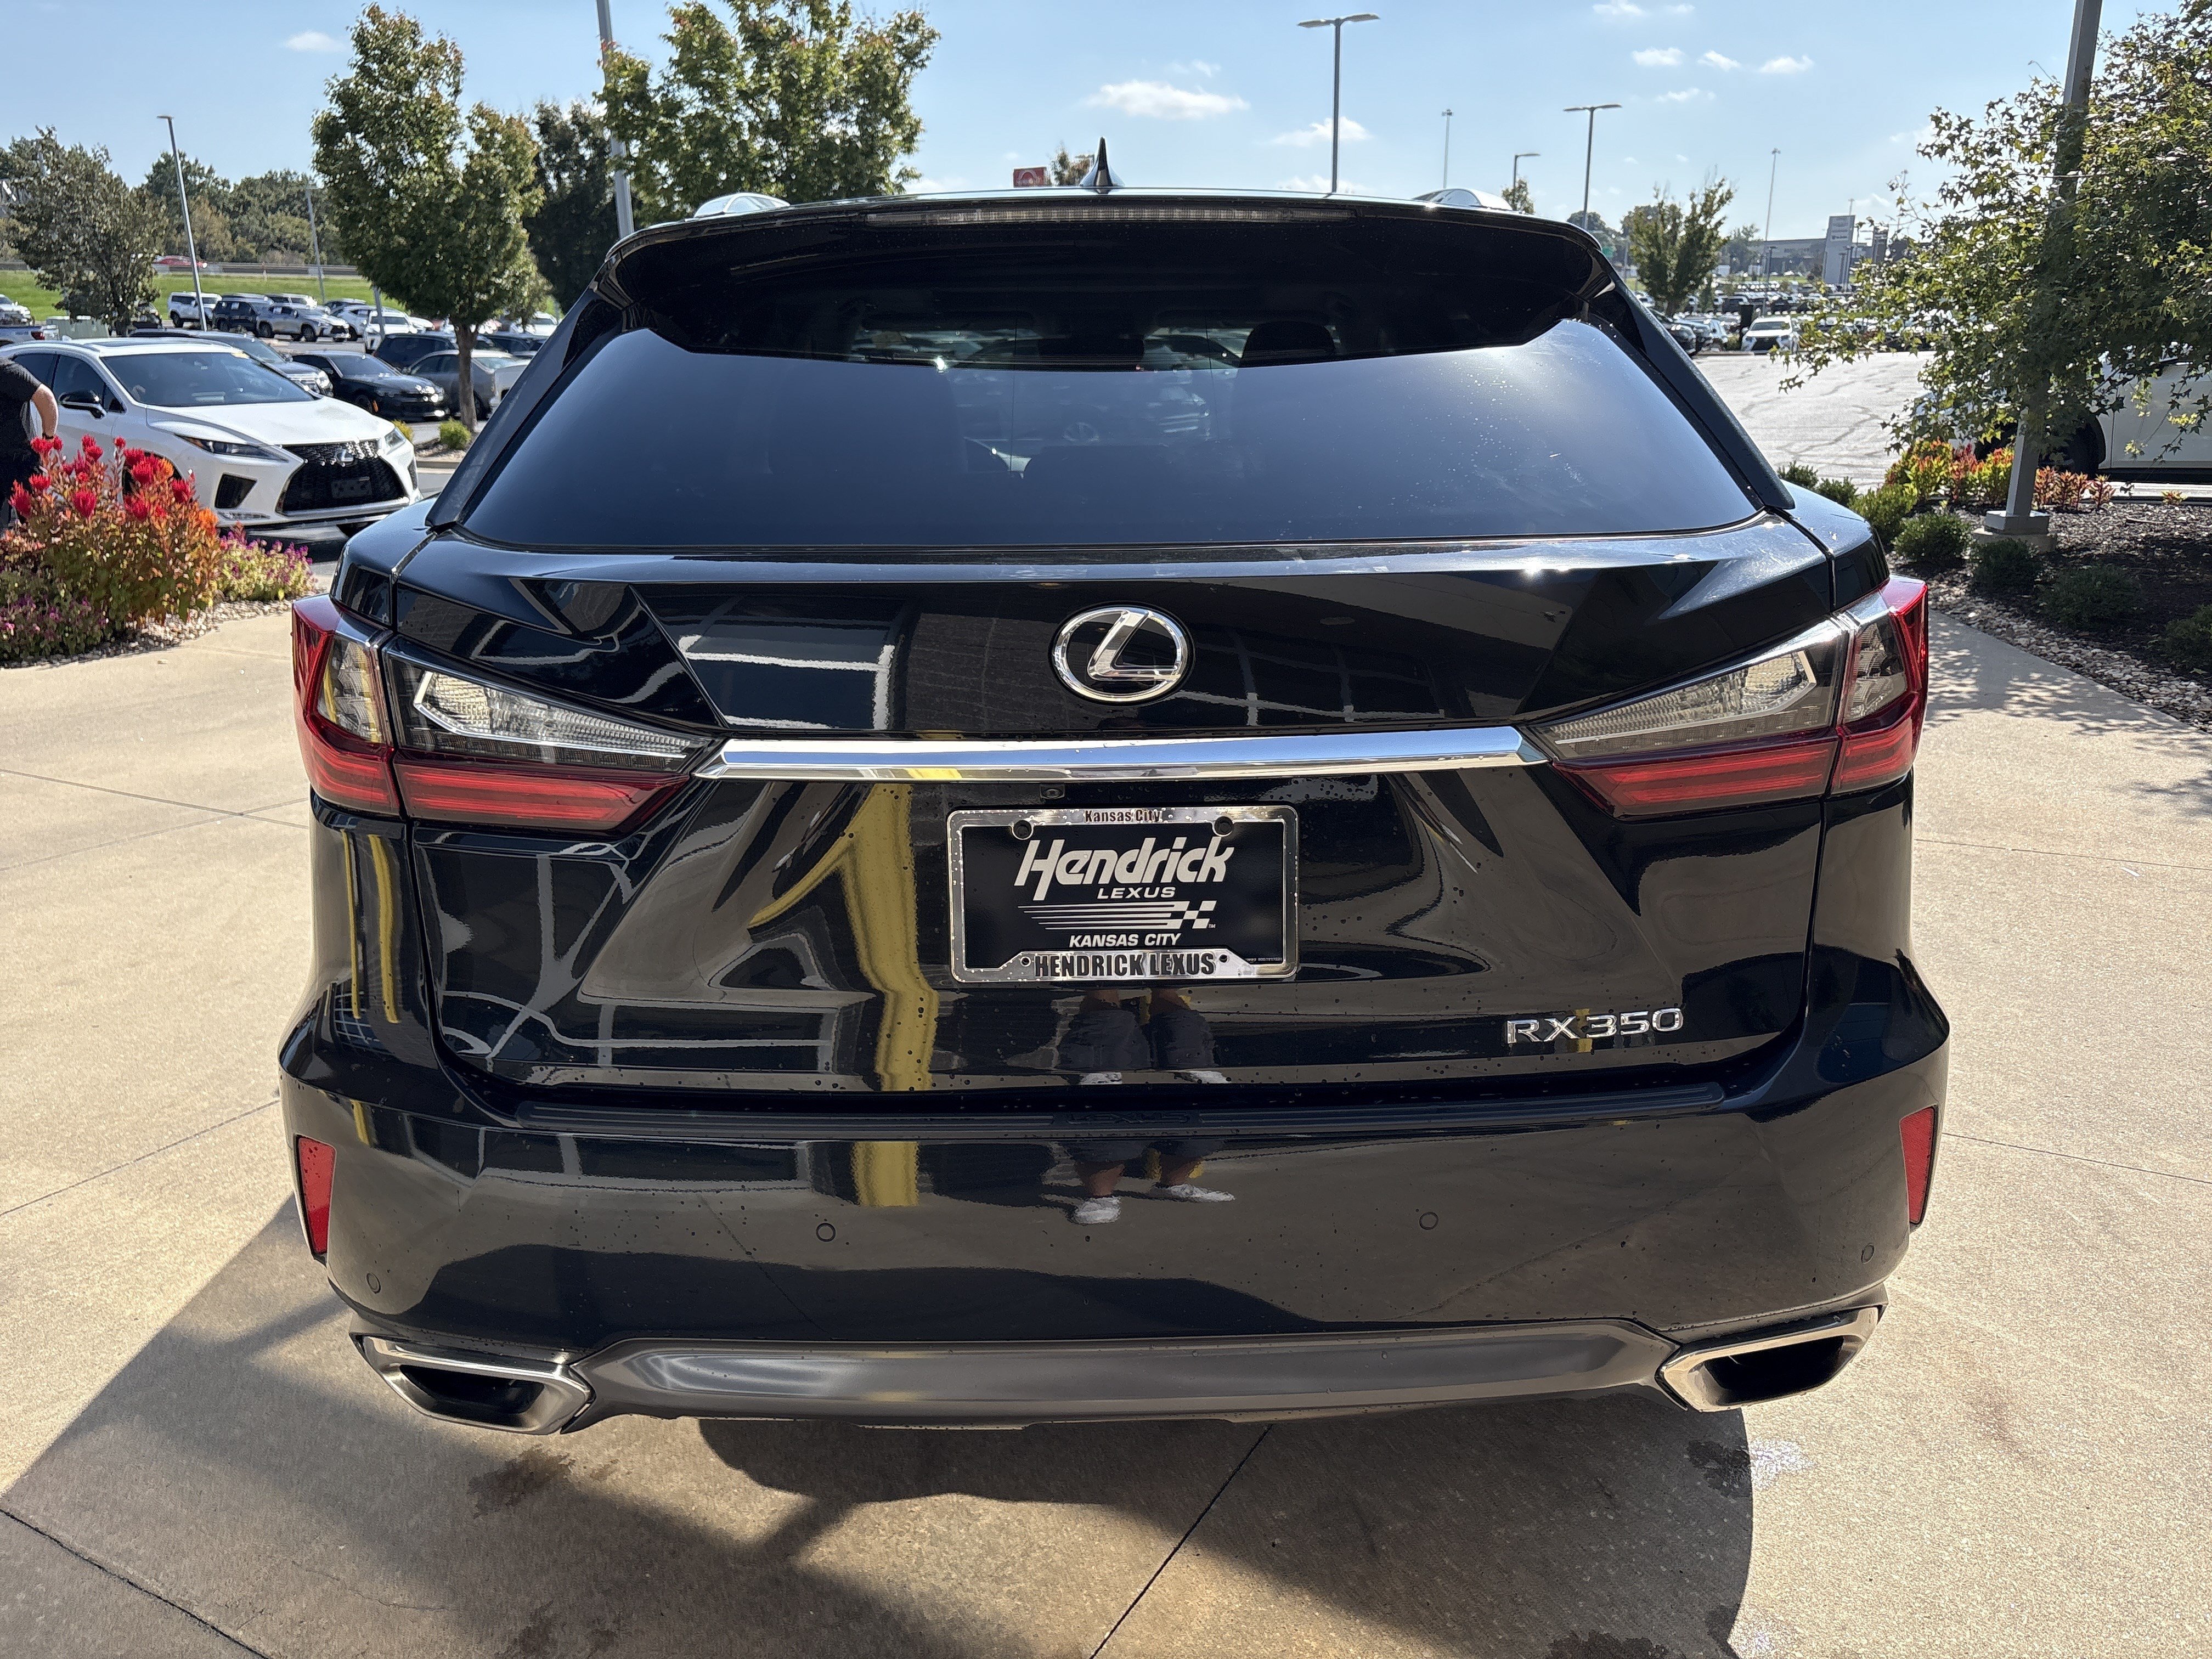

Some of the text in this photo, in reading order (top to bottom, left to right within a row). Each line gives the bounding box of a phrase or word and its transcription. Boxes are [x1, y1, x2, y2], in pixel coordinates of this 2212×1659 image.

[1085, 809, 1162, 822] Kansas City
[1014, 836, 1234, 901] Hendrick
[1097, 887, 1176, 899] LEXUS
[1069, 933, 1182, 948] KANSAS CITY
[1035, 952, 1216, 977] HENDRICK LEXUS
